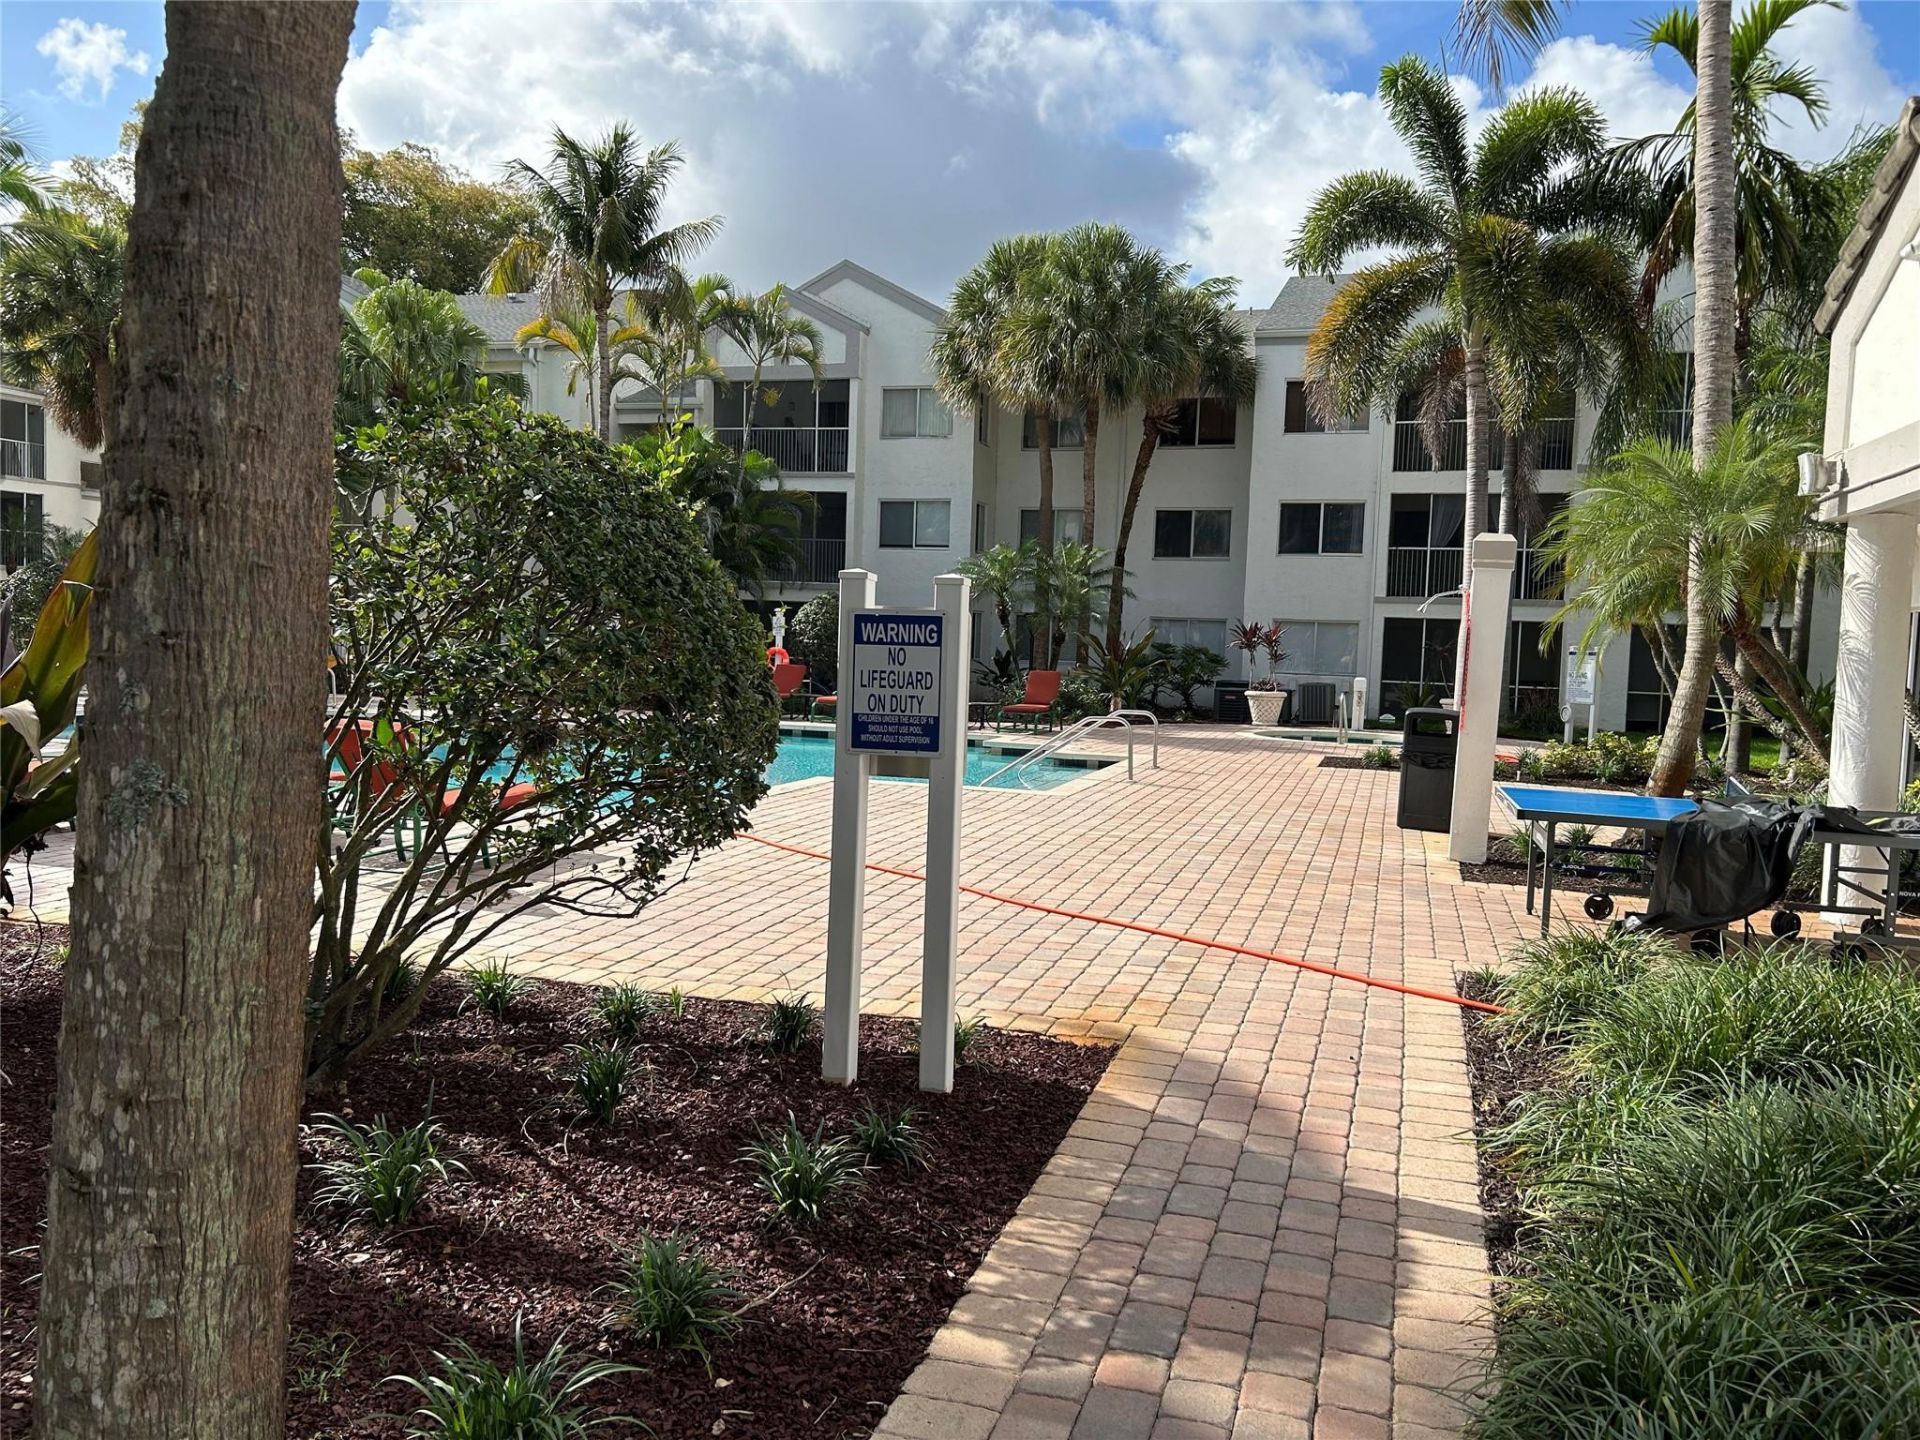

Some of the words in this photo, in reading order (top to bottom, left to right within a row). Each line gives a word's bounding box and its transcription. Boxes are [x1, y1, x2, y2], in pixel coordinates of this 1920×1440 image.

[861, 623, 938, 644] WARNING
[888, 647, 906, 666] NO
[860, 670, 933, 690] LIFEGUARD
[867, 694, 886, 712] ON
[890, 694, 924, 714] DUTY
[857, 714, 881, 722] CHILDREN
[882, 715, 898, 723] UNDER
[868, 724, 887, 732] SHOULD
[888, 725, 898, 733] NOT
[910, 726, 923, 734] POOL
[861, 734, 882, 742] WITHOUT
[882, 735, 898, 743] ADULT
[898, 735, 930, 744] SUPERVISION
